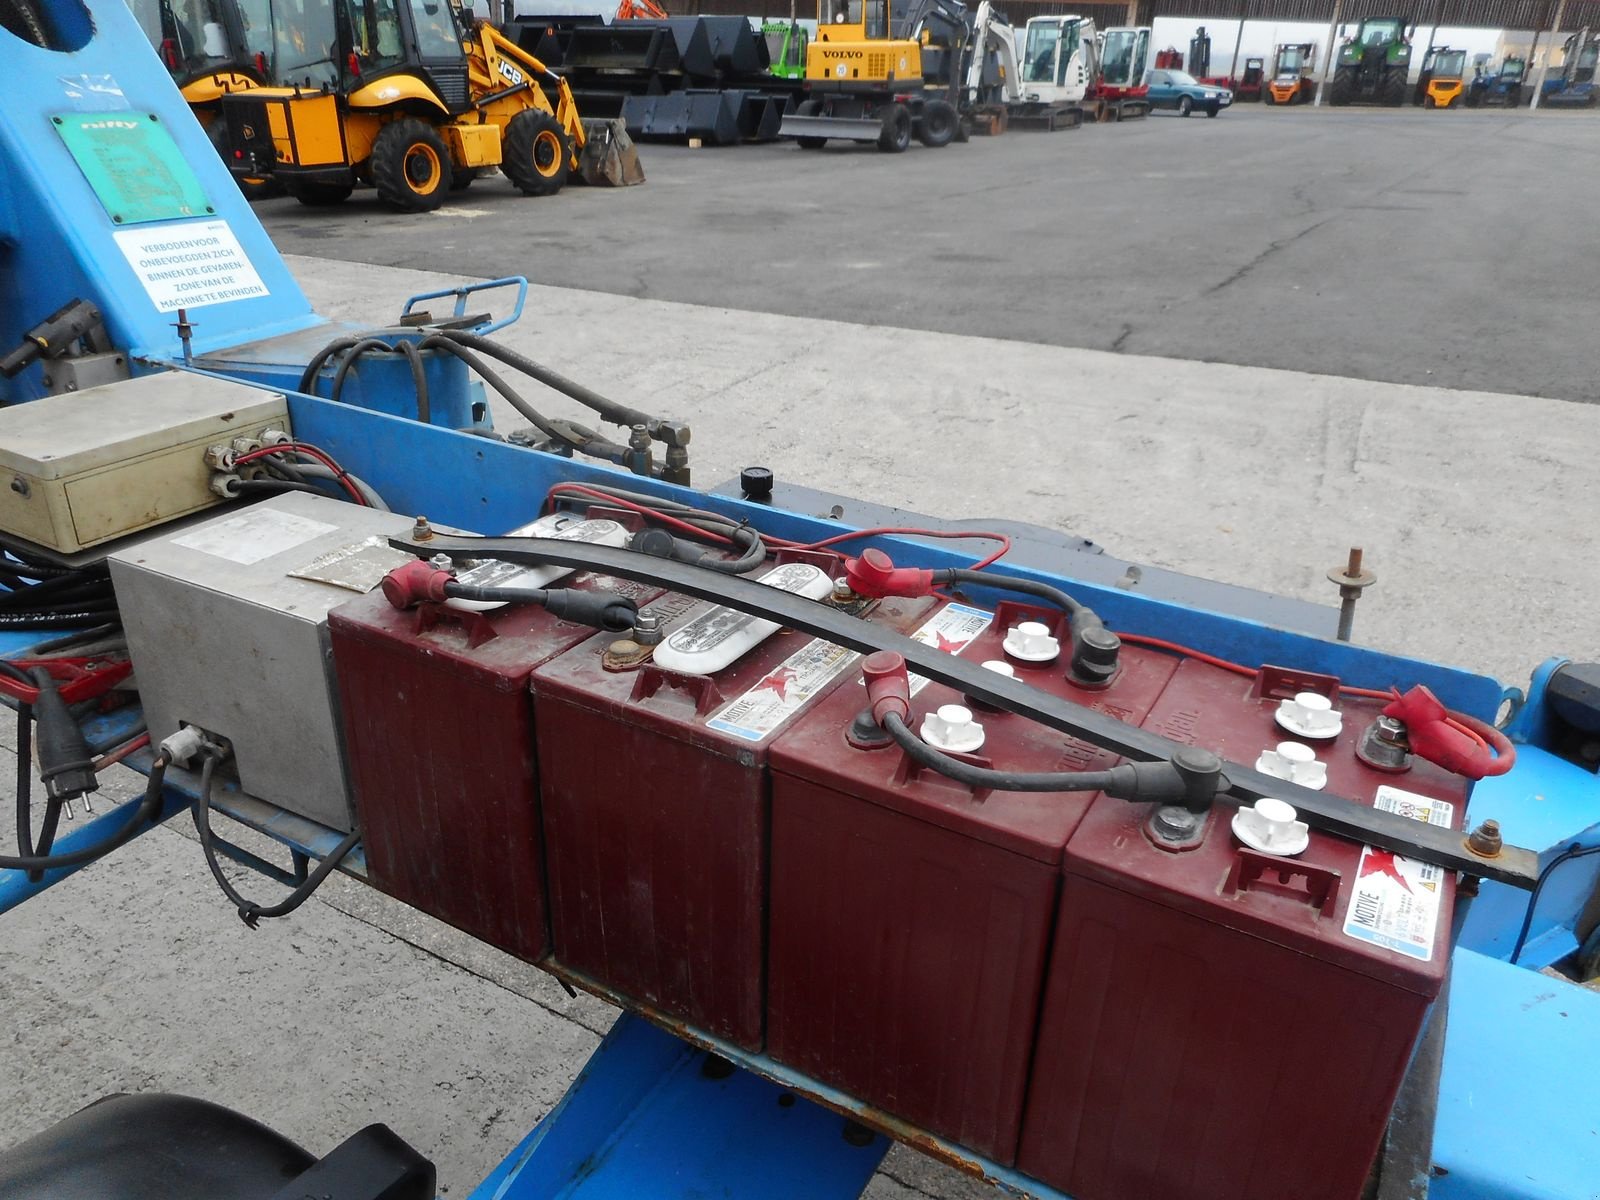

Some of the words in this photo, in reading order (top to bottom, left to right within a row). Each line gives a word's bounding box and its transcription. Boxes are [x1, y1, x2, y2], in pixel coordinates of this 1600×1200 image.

[823, 50, 863, 59] VOLVO
[497, 60, 523, 85] JCB
[80, 120, 139, 130] nifty
[141, 240, 193, 254] VERBODEN
[193, 237, 220, 247] VOOR
[139, 253, 212, 269] ONBEVOEGDEN
[212, 249, 235, 259] ZICH
[147, 269, 185, 282] BINNEN
[185, 266, 199, 276] DE
[200, 261, 245, 274] GEVAREN-
[173, 281, 203, 293] ZONE
[201, 278, 222, 289] VAN
[222, 275, 236, 285] DE
[160, 295, 205, 309] MACHINE
[204, 293, 217, 303] TE
[217, 285, 263, 300] BEVINDEN
[962, 616, 988, 635] MOTIVE
[720, 699, 755, 723] MOTIVE
[1352, 890, 1380, 928] MOTIVE
